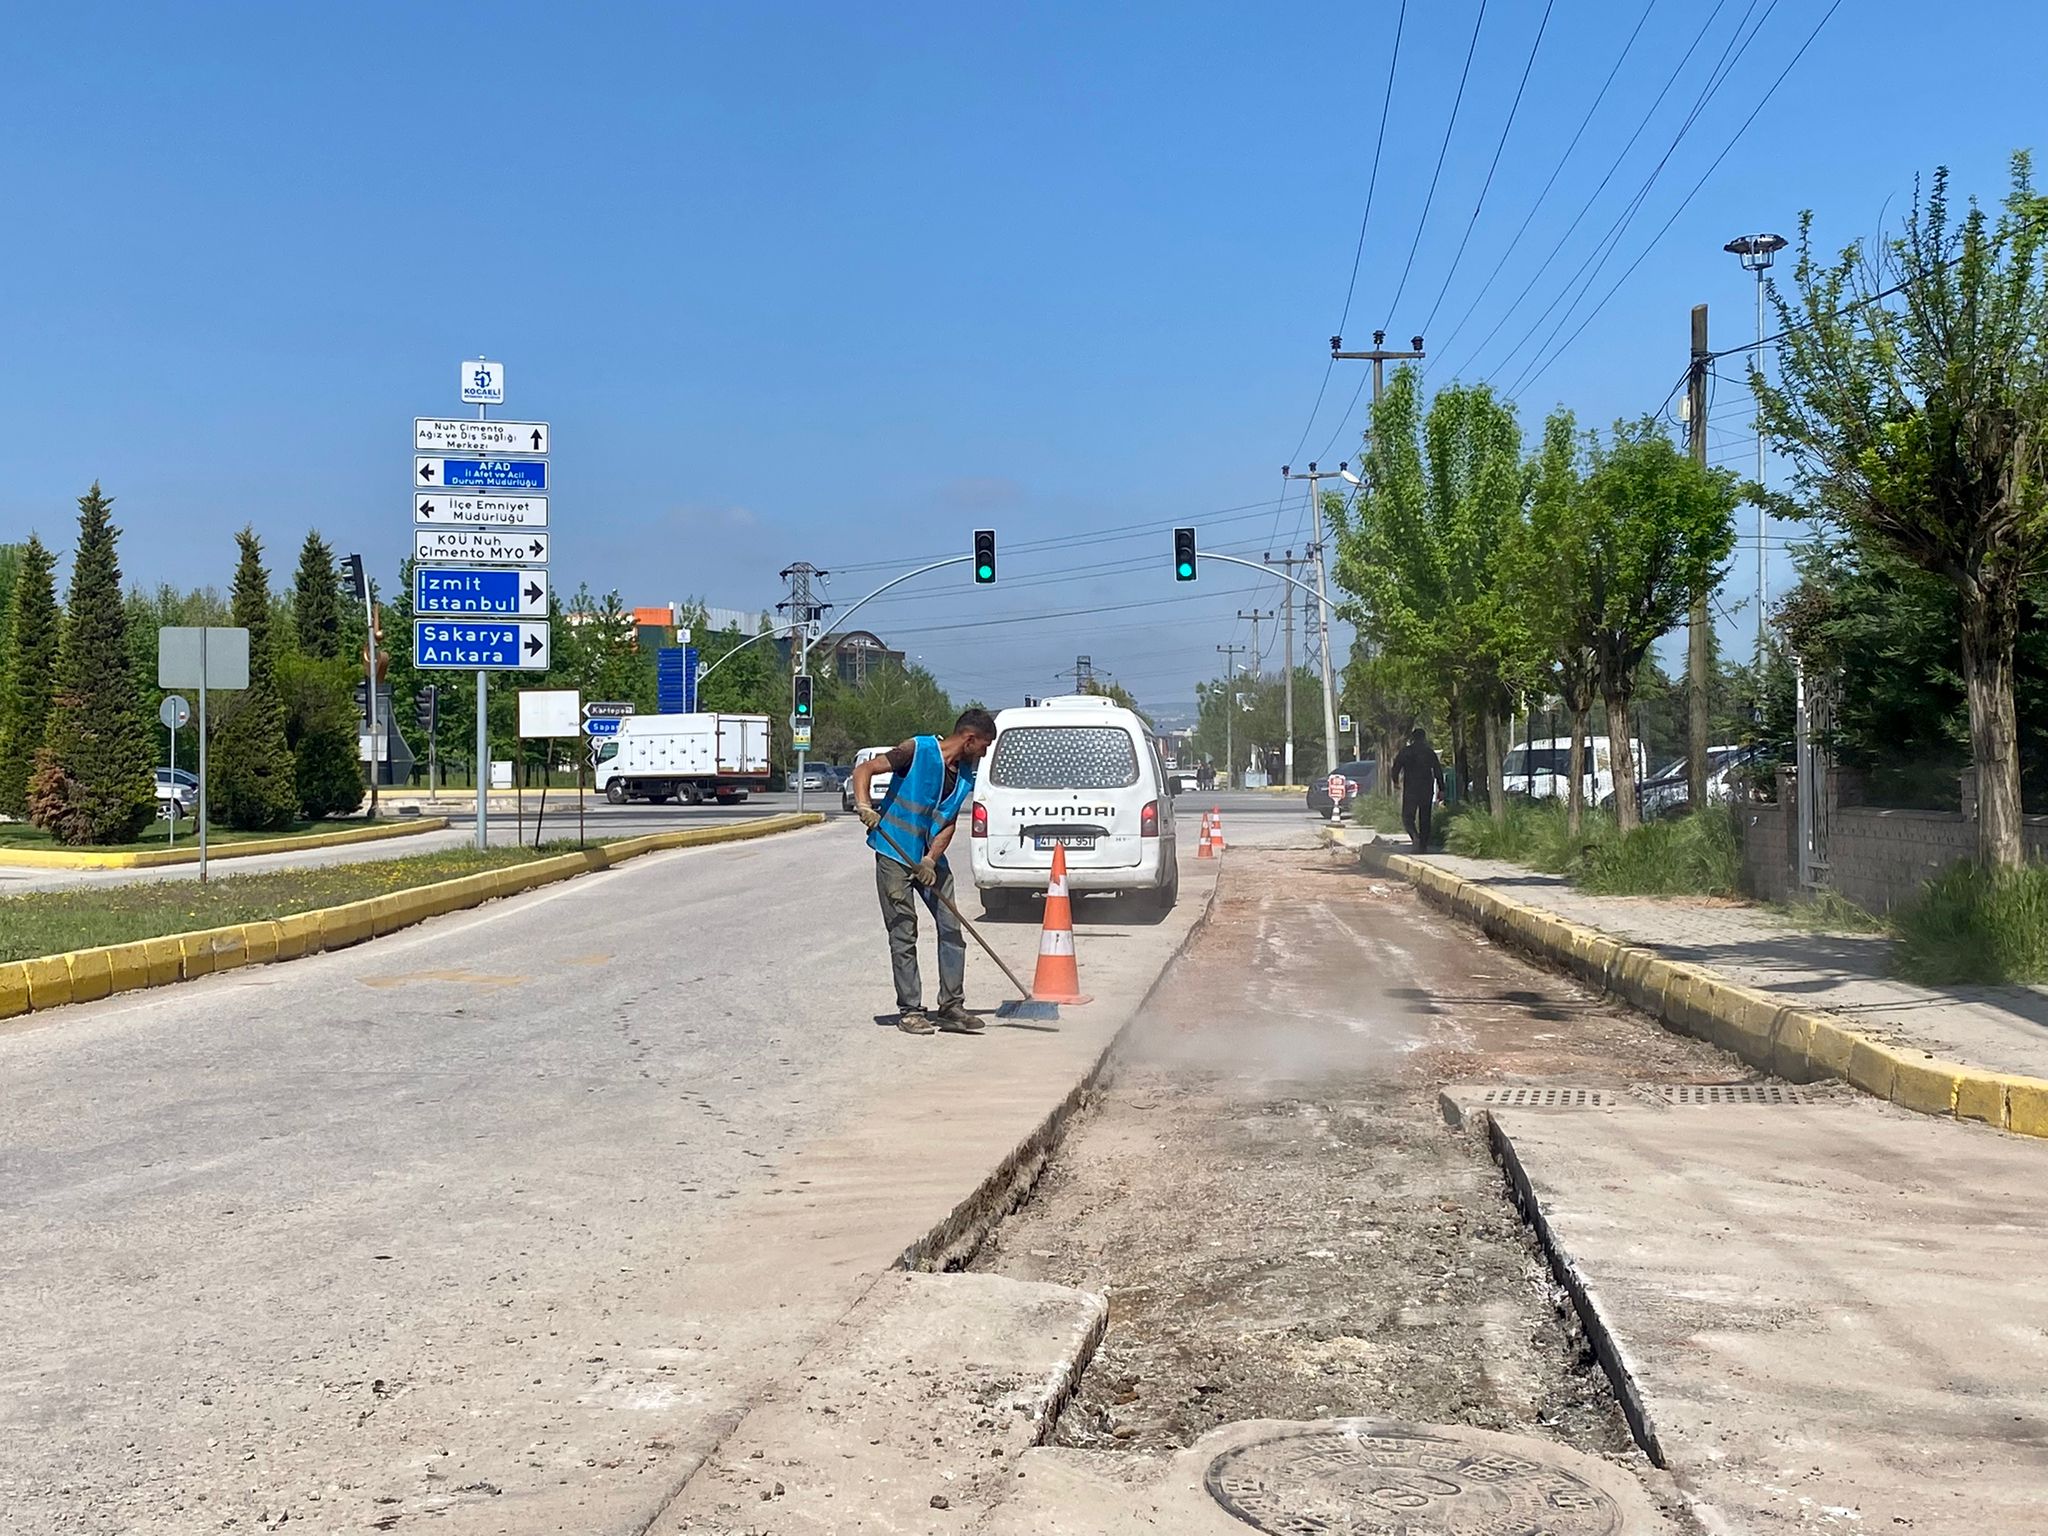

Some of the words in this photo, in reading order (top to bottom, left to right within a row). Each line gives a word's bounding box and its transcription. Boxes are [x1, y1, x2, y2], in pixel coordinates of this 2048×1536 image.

[464, 388, 501, 396] KOCAELİ
[434, 423, 456, 431] Nuh
[479, 462, 511, 471] AFAD
[452, 477, 484, 485] Durum
[507, 471, 524, 479] Acil
[449, 498, 472, 510] İlçe
[477, 501, 530, 512] Emniyet
[454, 512, 524, 524] Müdürlüğü
[438, 533, 467, 545] KOÜ
[473, 535, 501, 546] Nuh
[419, 545, 485, 558] Çimento
[491, 547, 524, 559] MYO
[421, 571, 481, 591] İzmit
[421, 591, 515, 611] İstanbul
[424, 626, 513, 646] Sakarya
[423, 647, 503, 662] Ankara
[1012, 806, 1115, 817] HYUNDAI
[1040, 836, 1050, 846] 41
[1075, 836, 1092, 846] 951
